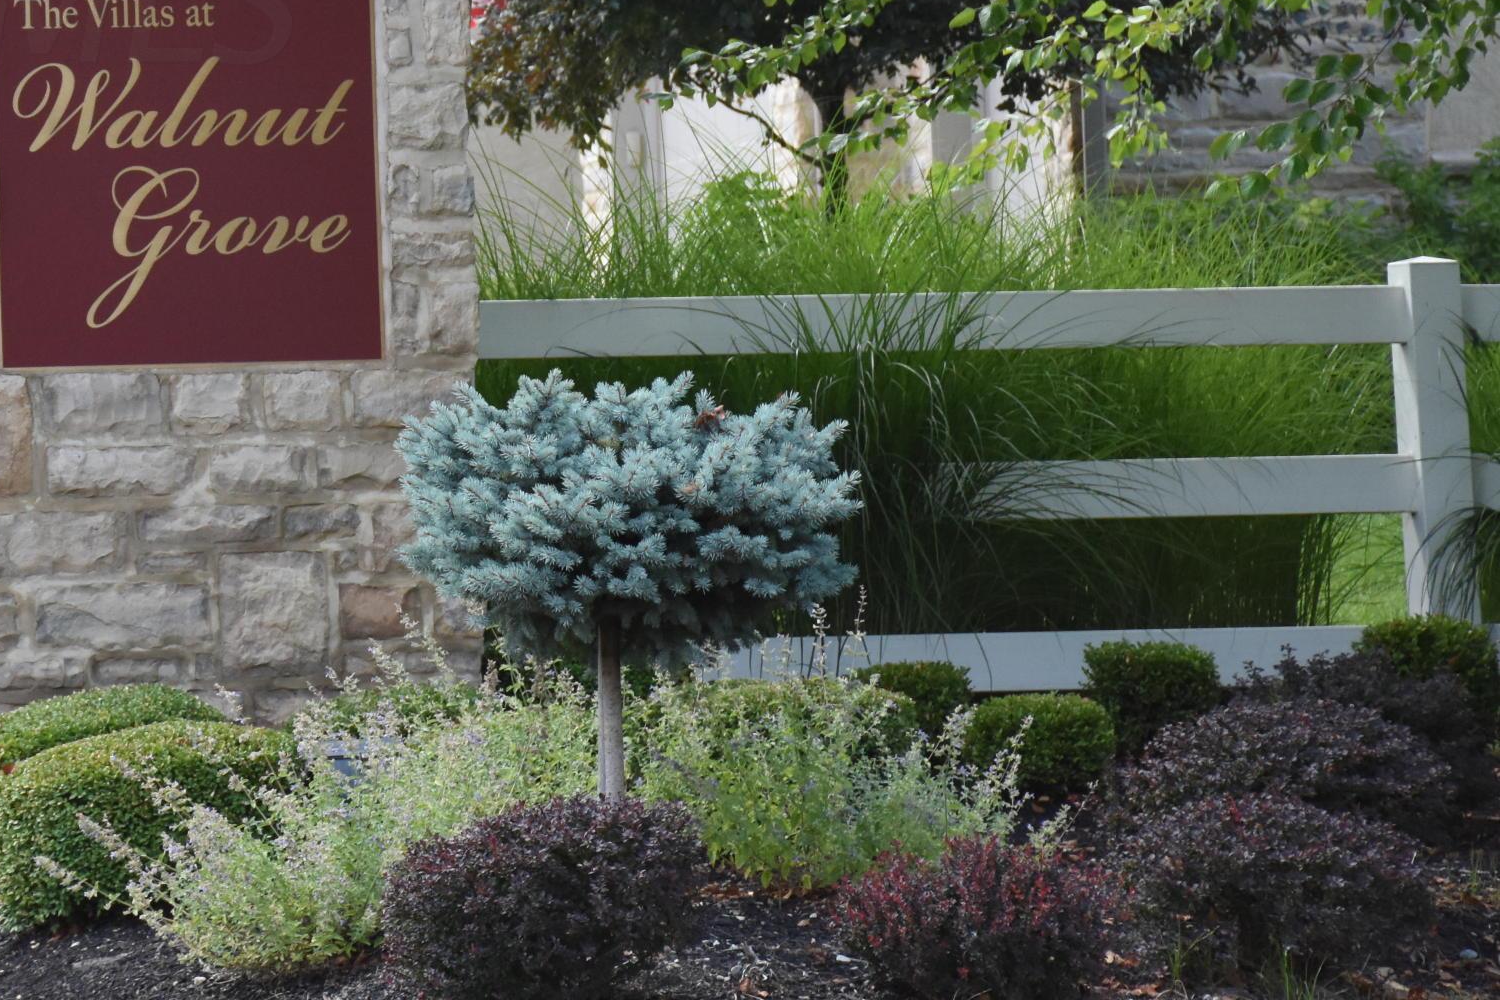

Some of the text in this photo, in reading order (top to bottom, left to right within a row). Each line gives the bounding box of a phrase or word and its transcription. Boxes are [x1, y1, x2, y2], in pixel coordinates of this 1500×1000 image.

[186, 1, 216, 28] at
[12, 56, 355, 153] Walnut
[86, 165, 352, 329] Grove
